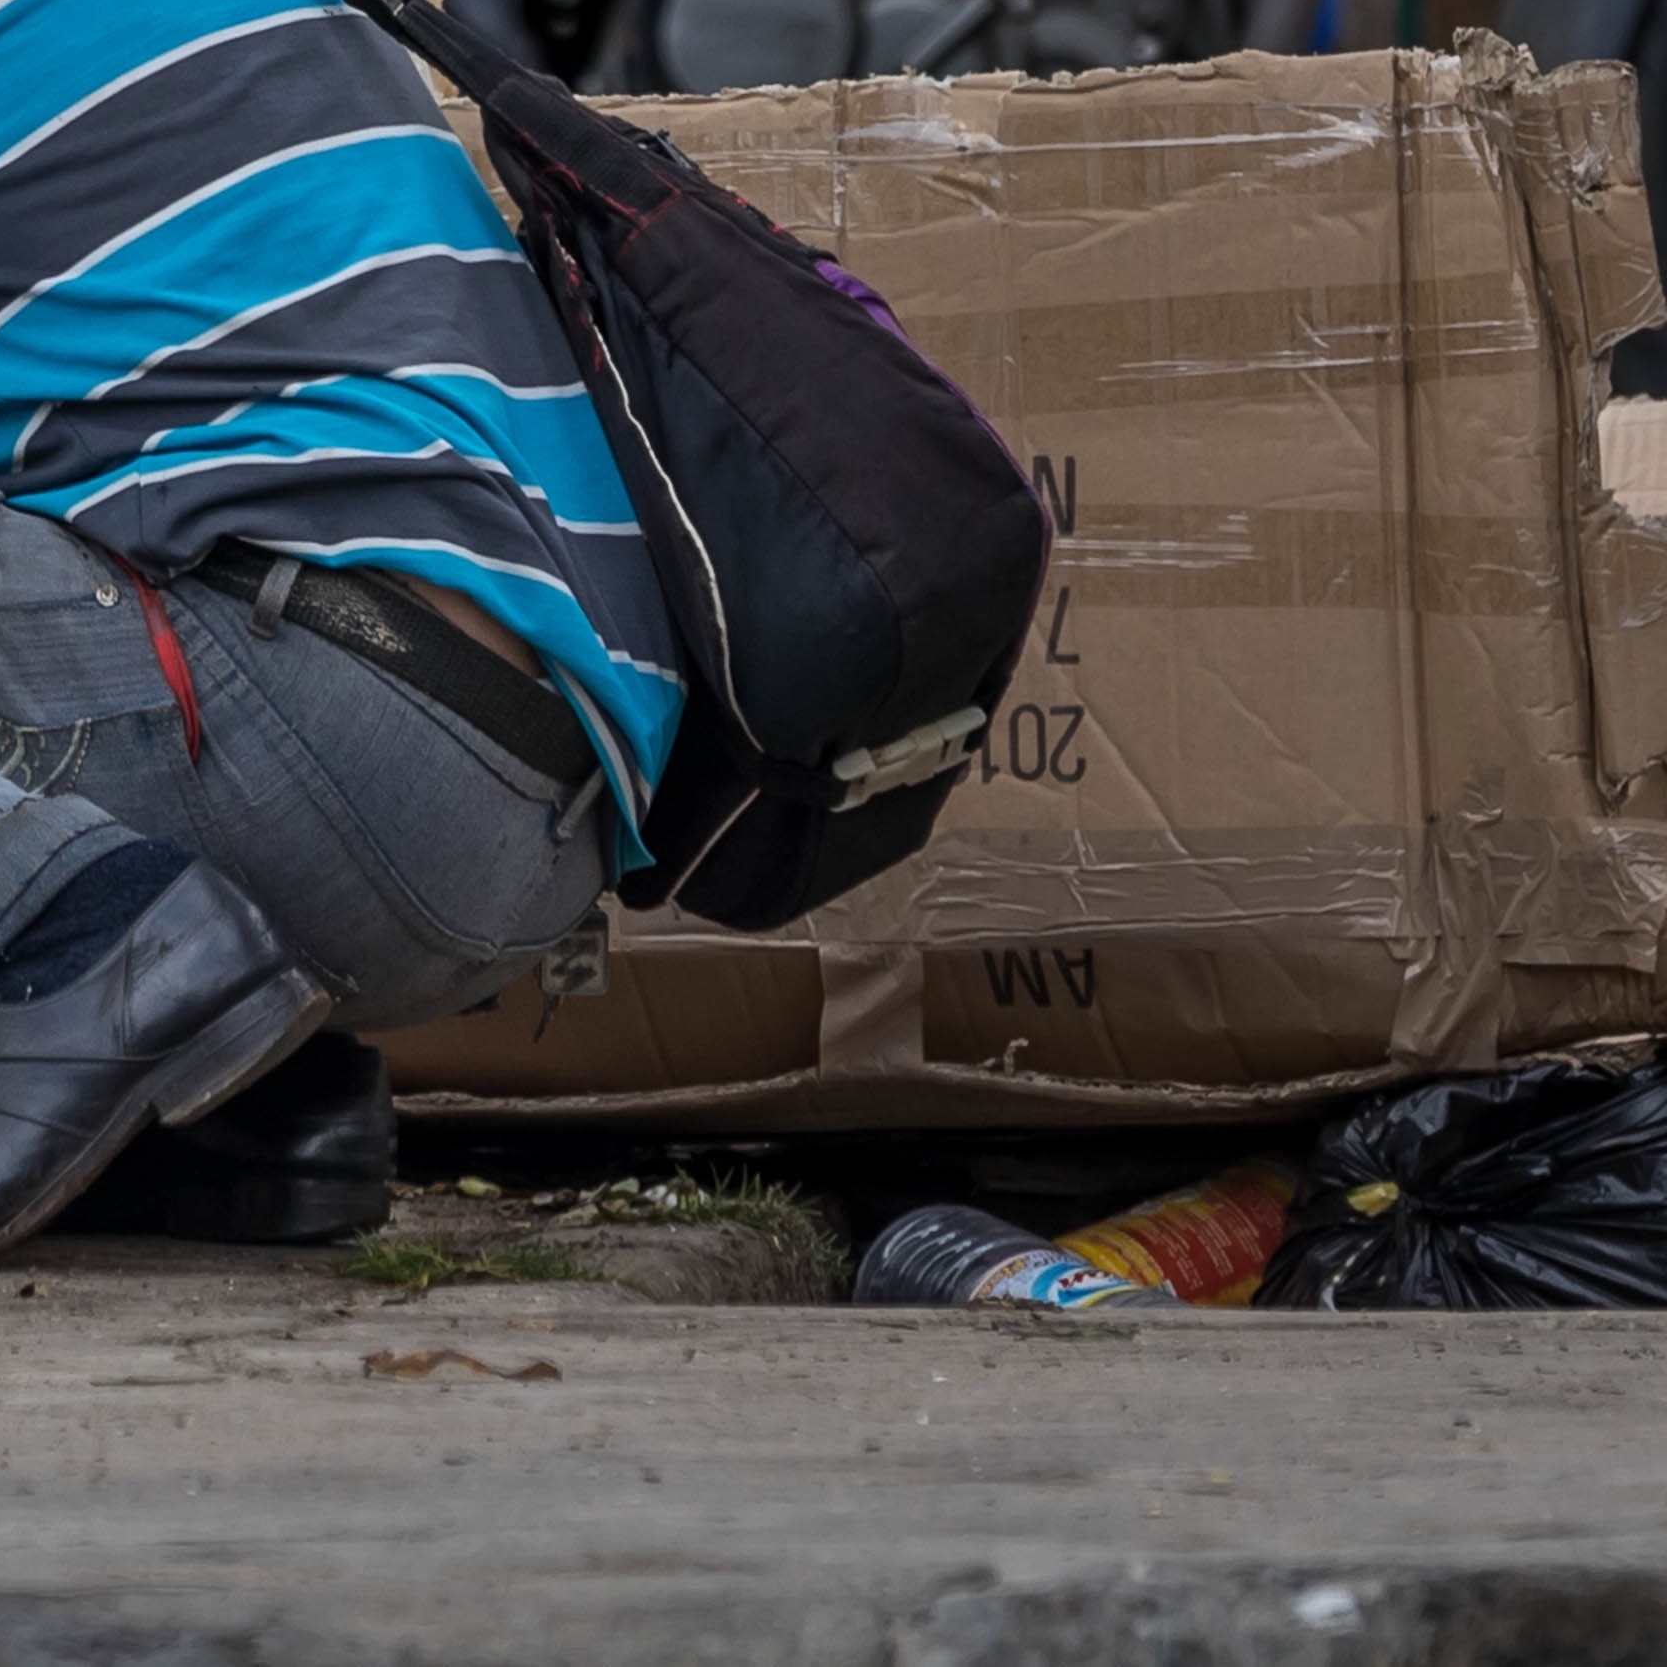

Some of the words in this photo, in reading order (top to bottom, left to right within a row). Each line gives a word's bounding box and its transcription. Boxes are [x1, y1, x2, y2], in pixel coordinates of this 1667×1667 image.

[1046, 585, 1080, 665] 7
[955, 704, 1086, 787] 201
[982, 947, 1095, 1011] AM
